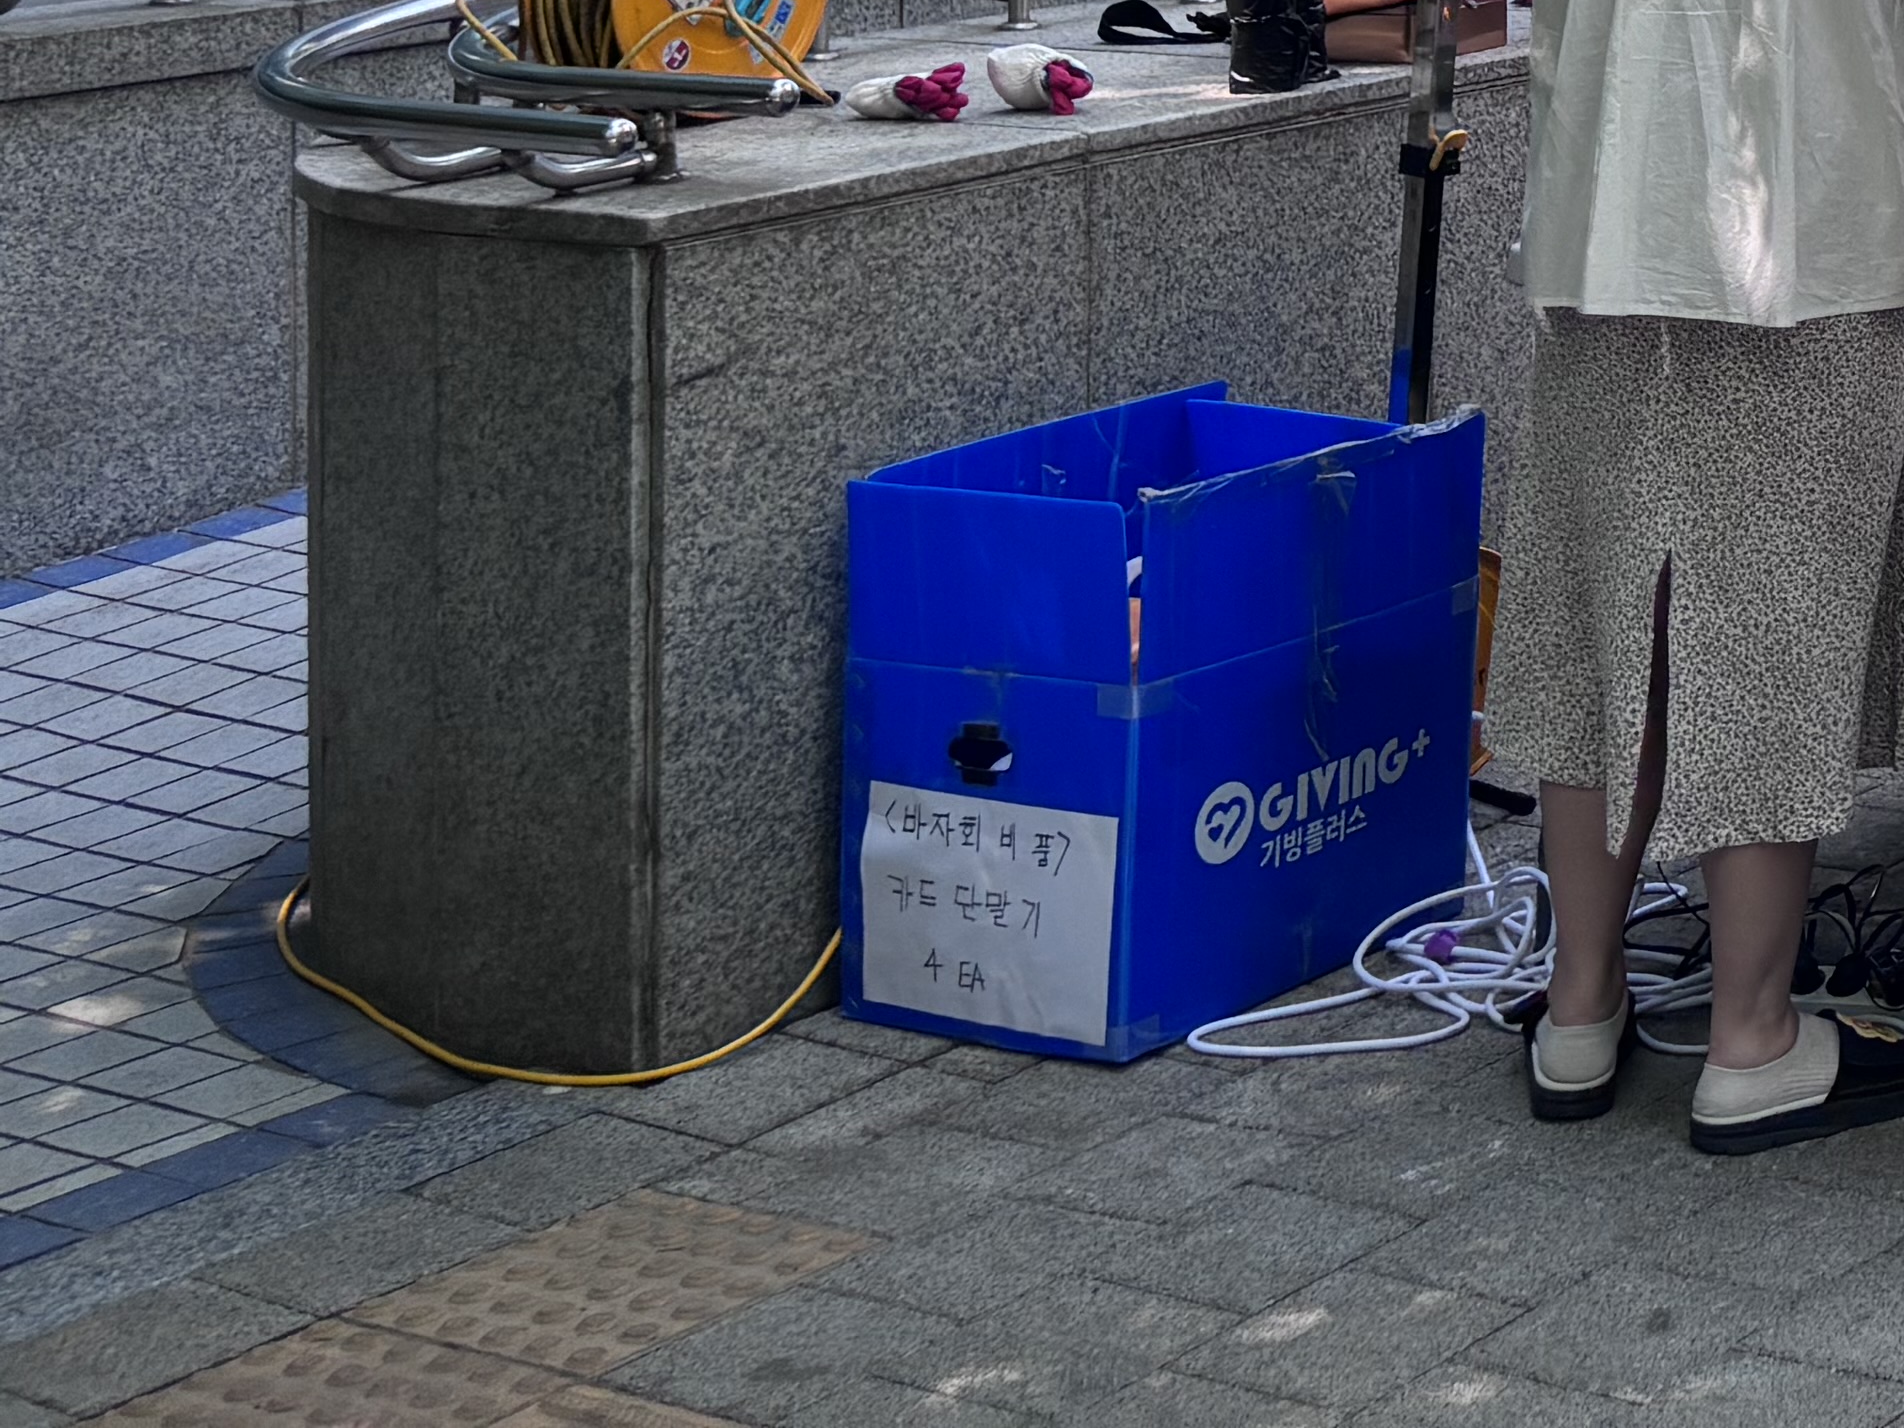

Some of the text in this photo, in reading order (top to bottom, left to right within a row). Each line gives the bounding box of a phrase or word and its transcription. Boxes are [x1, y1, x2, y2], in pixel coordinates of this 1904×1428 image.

[1258, 804, 1369, 870] 기빙플러스
[887, 873, 939, 913] 카드
[923, 947, 986, 994] 4 EA
